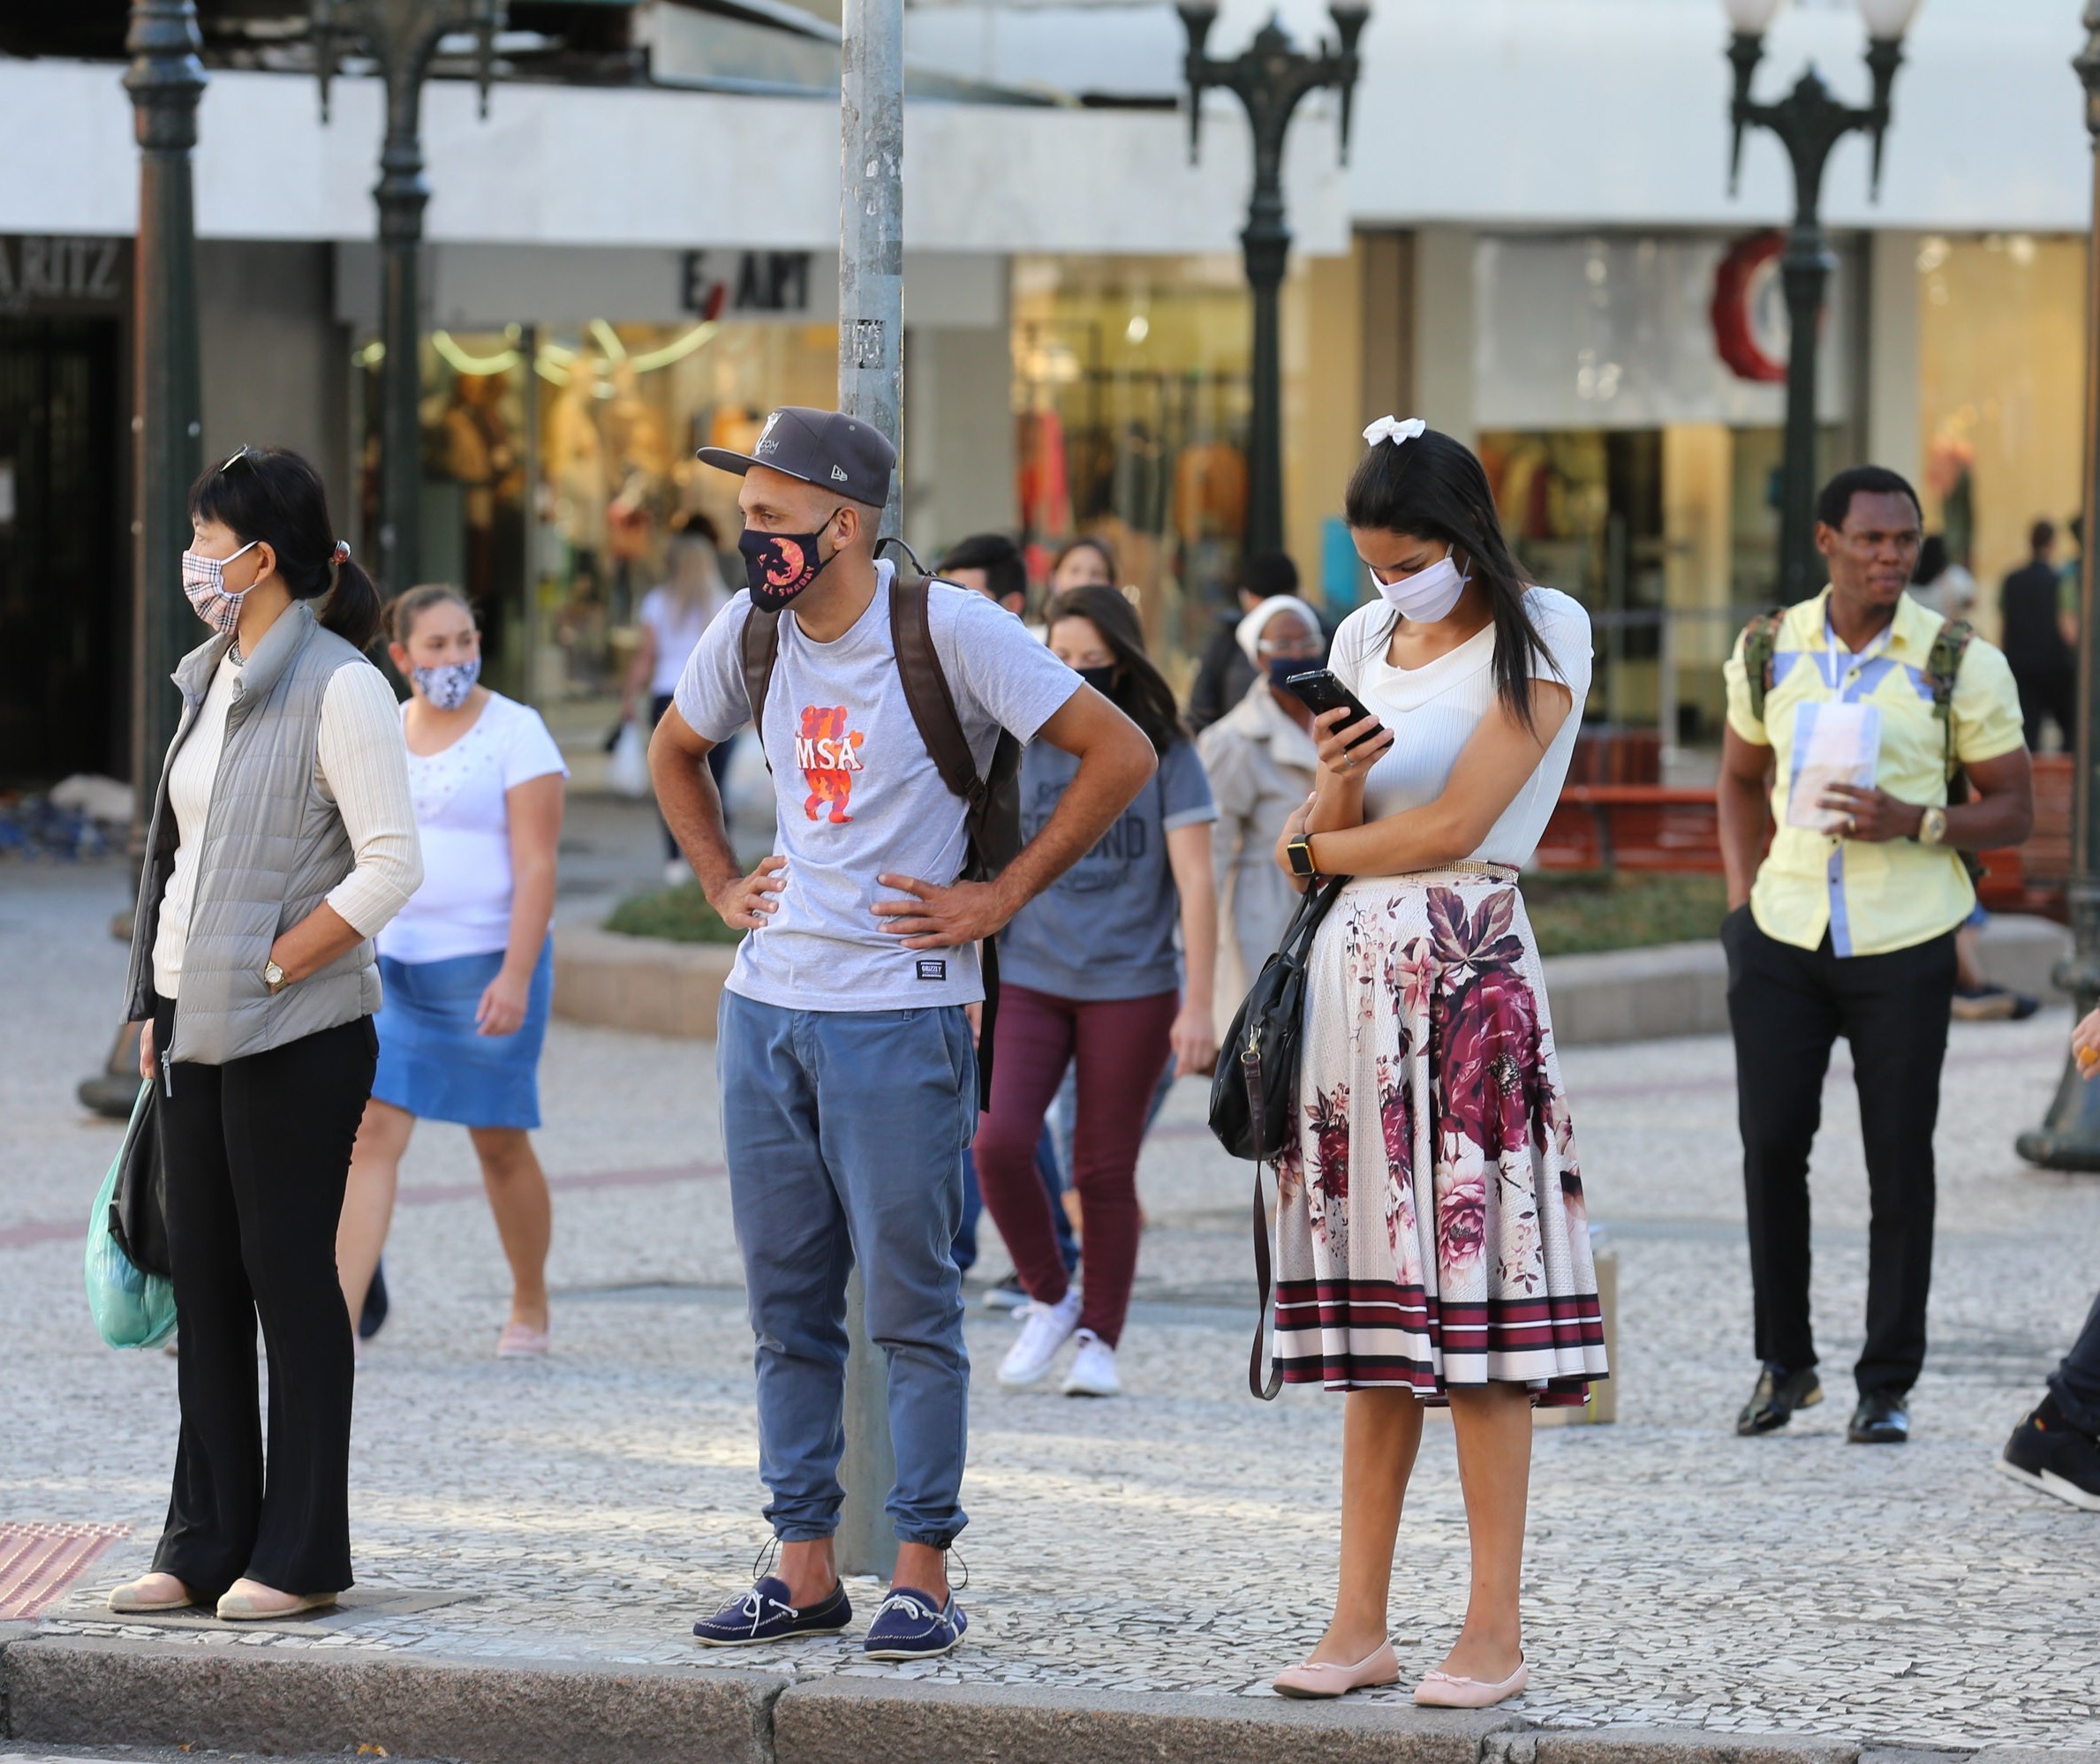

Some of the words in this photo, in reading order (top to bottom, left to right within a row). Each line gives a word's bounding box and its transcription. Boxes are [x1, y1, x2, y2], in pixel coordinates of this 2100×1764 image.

[21, 237, 121, 298] RITZ
[762, 583, 774, 595] EL
[778, 566, 814, 596] SHADAY
[795, 736, 864, 771] MSA
